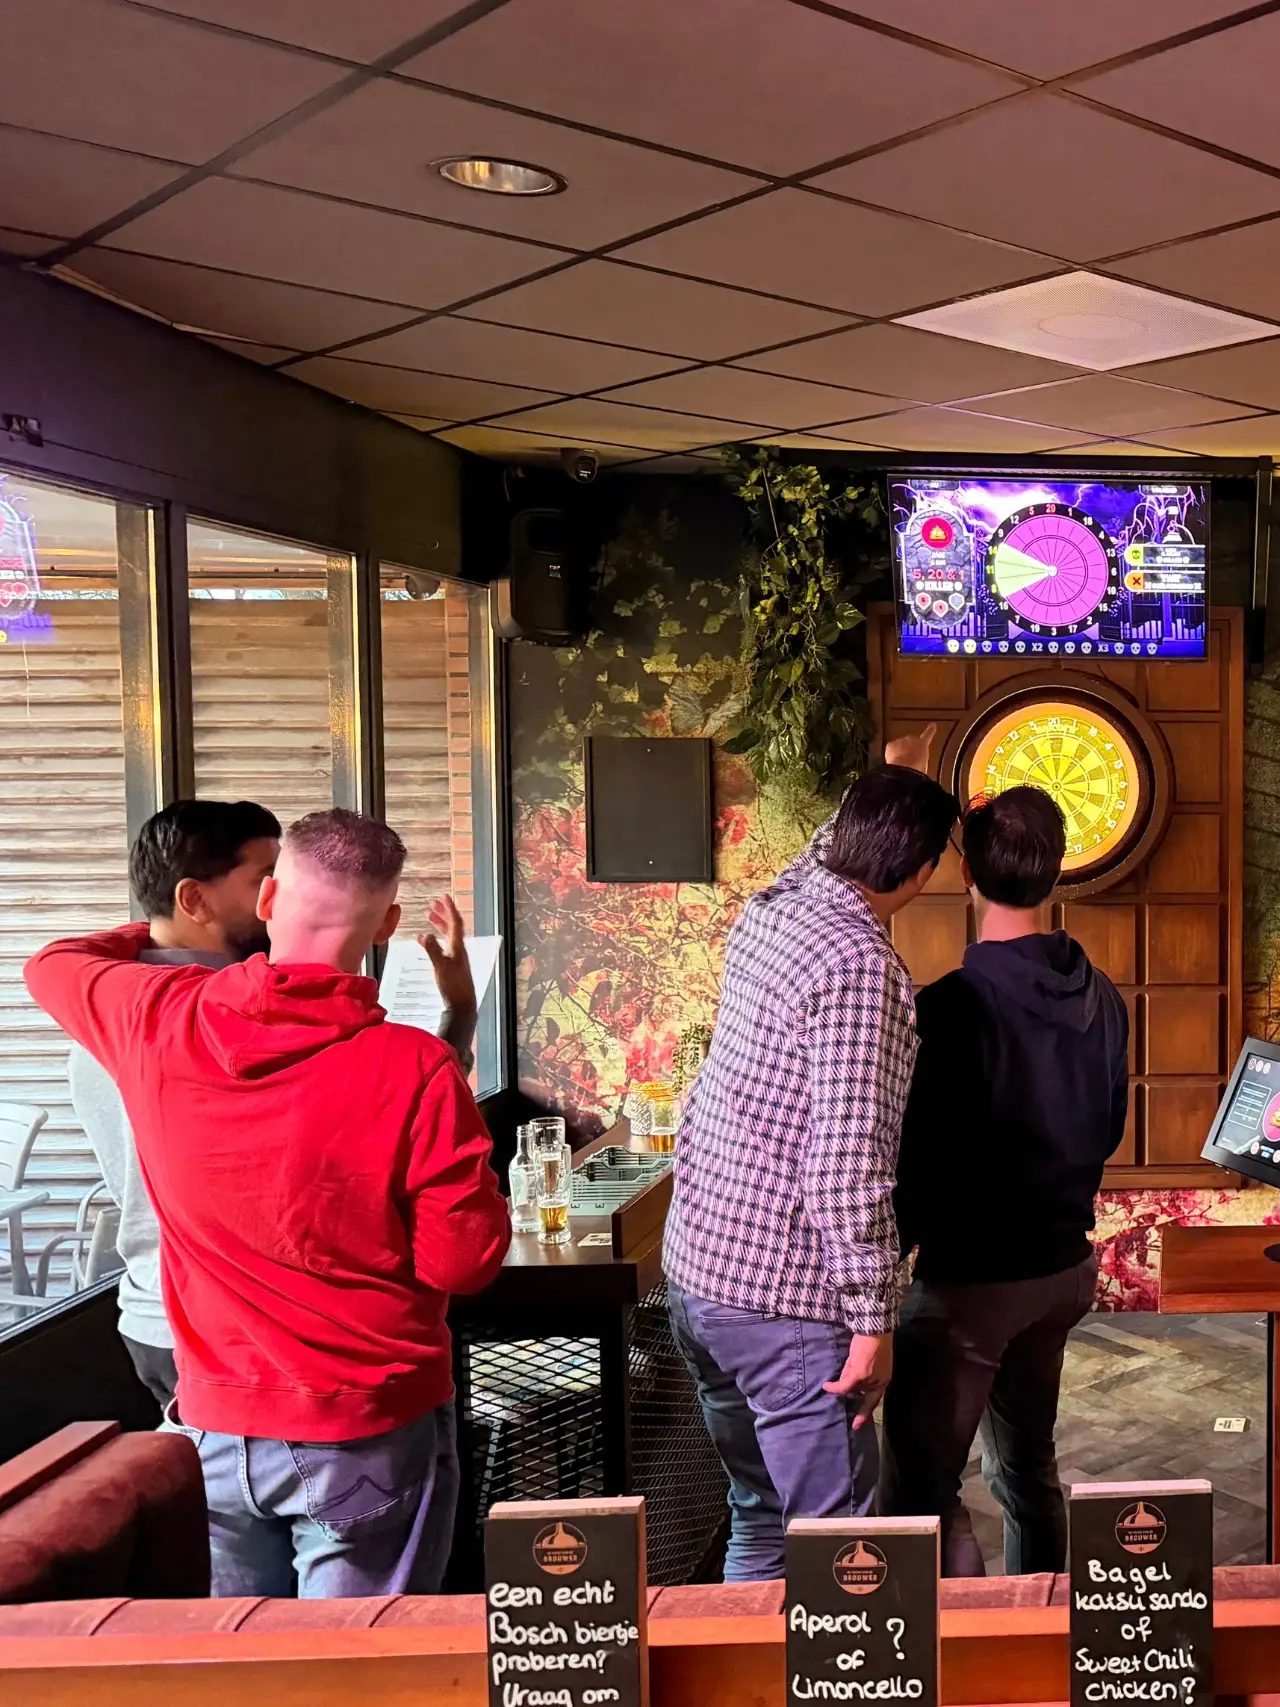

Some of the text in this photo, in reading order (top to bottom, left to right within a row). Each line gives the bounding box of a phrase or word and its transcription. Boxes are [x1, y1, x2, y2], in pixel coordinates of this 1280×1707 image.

[1046, 504, 1056, 513] 20
[1010, 516, 1019, 524] 12
[1099, 530, 1104, 539] 4
[1107, 548, 1115, 557] 13
[928, 569, 944, 580] 20
[947, 569, 956, 580] &
[959, 570, 964, 580] 1
[1099, 603, 1108, 611] 15
[1087, 616, 1093, 625] 2
[1030, 624, 1040, 632] 19
[1051, 628, 1057, 636] 3
[1068, 625, 1078, 633] 17
[1032, 643, 1043, 651] X2
[1088, 1559, 1172, 1593] Bagel
[553, 1580, 615, 1606] echt
[1149, 1588, 1207, 1611] sando
[489, 1611, 568, 1645] Bosch
[790, 1604, 905, 1660] Aperol ?
[1121, 1616, 1152, 1642] of
[836, 1650, 865, 1670] of
[1074, 1644, 1194, 1675] Sweet Chili
[492, 1650, 607, 1686] proberen?
[792, 1674, 923, 1700] Limoncello
[582, 1688, 620, 1704] om
